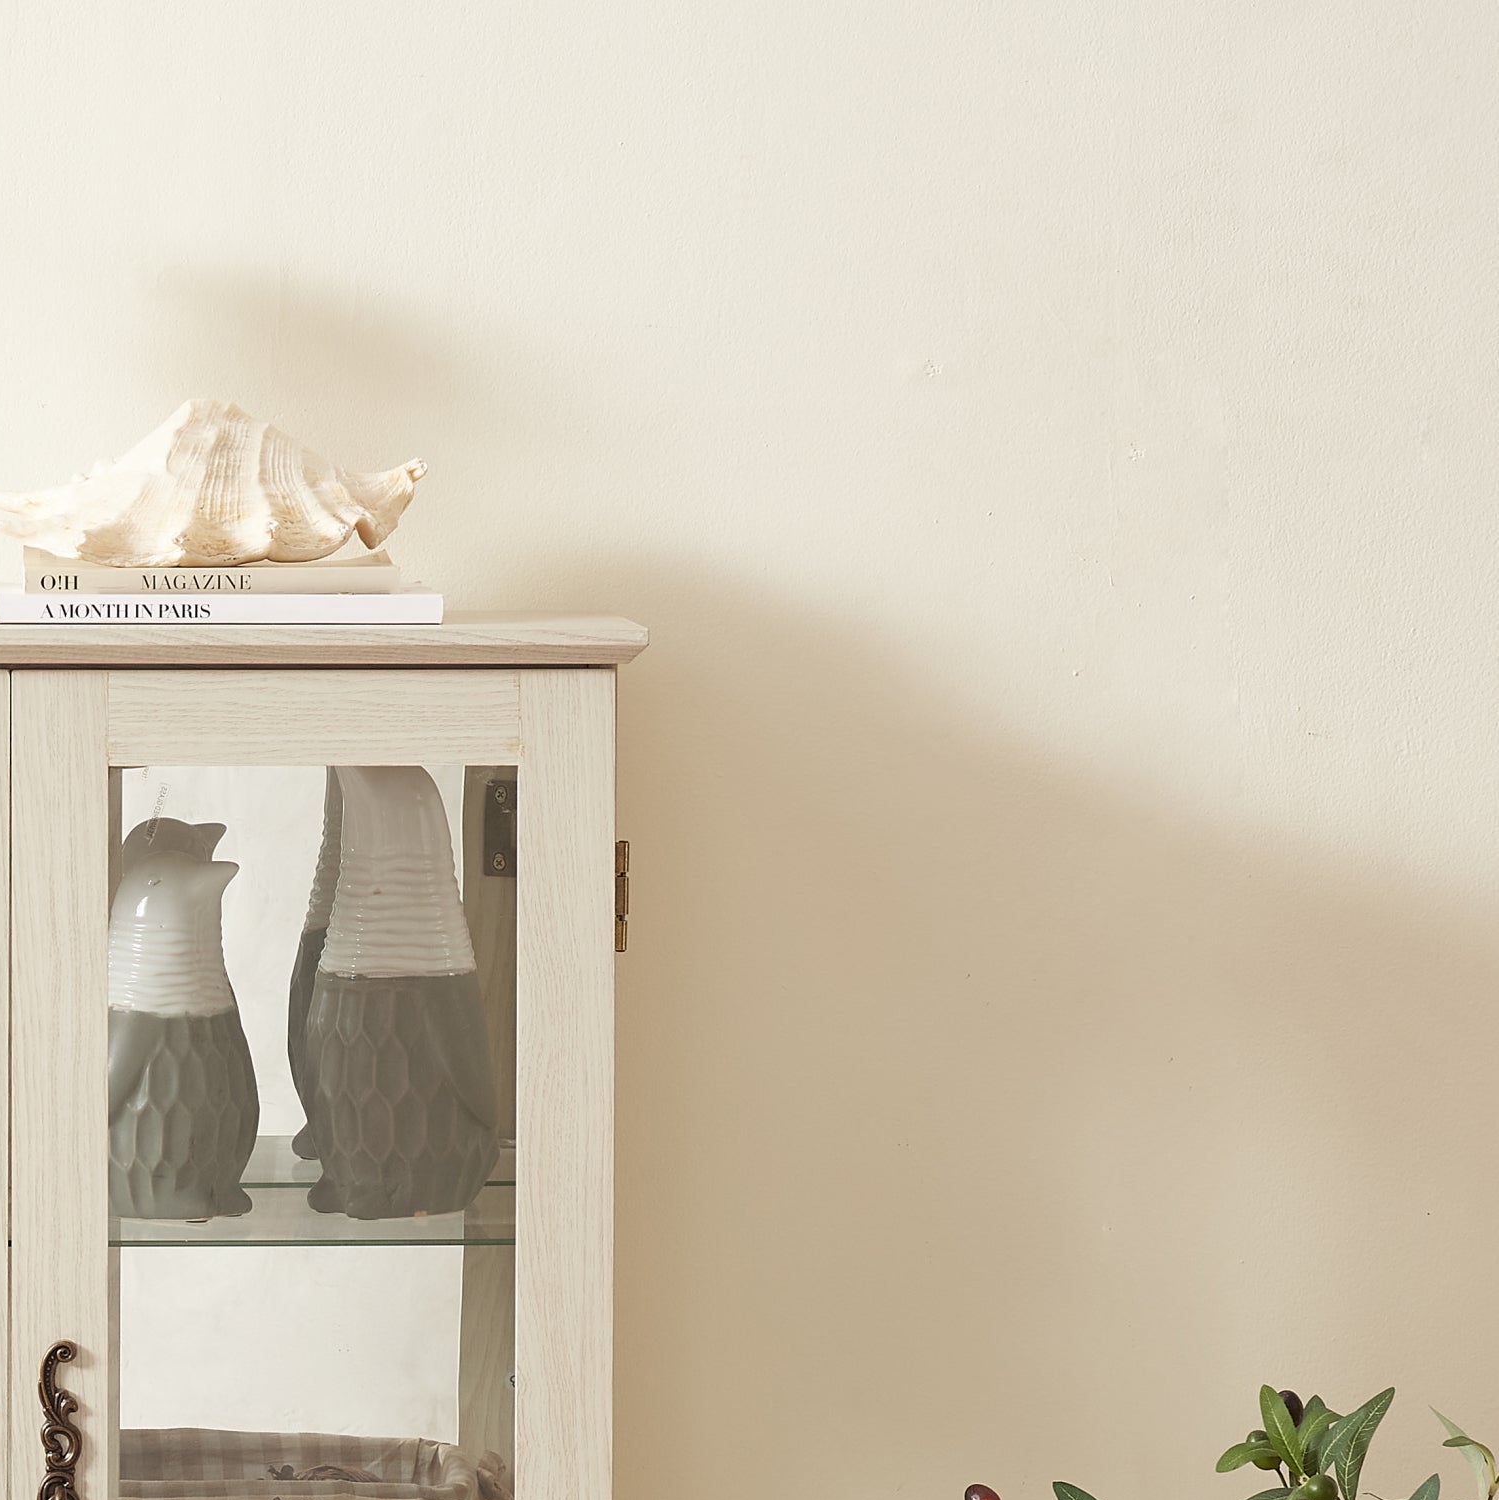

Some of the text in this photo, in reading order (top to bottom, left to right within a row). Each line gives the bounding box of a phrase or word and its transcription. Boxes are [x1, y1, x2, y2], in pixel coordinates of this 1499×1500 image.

[40, 575, 251, 590] O!H MAGAZINE
[40, 603, 211, 618] A MONTH IN PARIS
